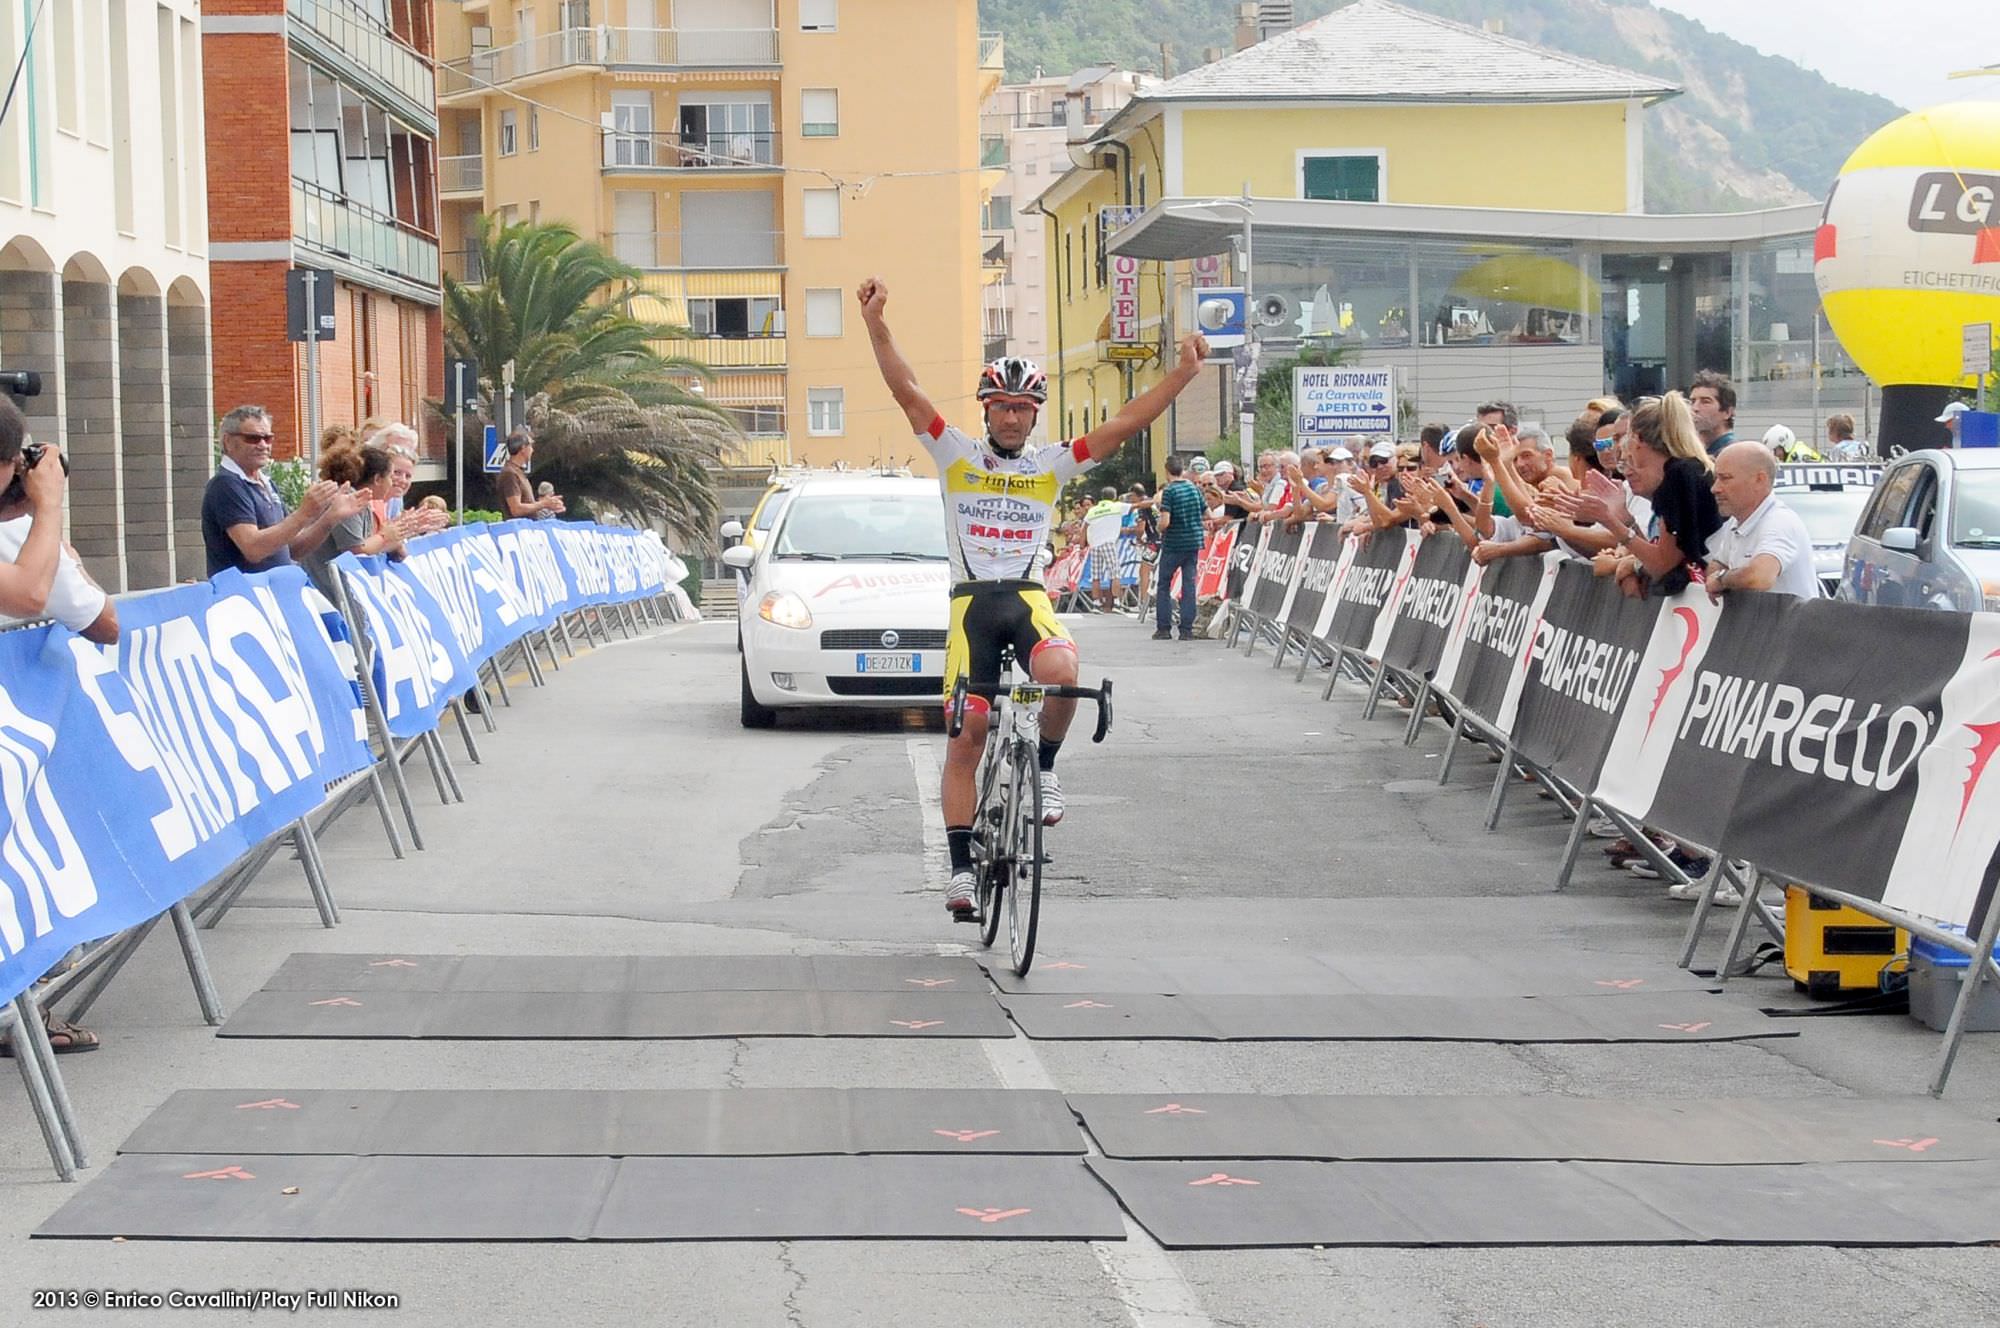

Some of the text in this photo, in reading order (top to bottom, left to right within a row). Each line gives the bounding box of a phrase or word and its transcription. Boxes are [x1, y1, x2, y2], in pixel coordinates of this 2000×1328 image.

[1918, 184, 2000, 224] LG
[1115, 256, 1135, 340] OTEL
[1303, 373, 1388, 387] HOTEL RISTORANTE
[1307, 389, 1383, 400] La Caravella
[1316, 403, 1368, 412] APERTO
[1304, 418, 1314, 430] P
[1318, 418, 1343, 429] AMPIO
[1774, 467, 1884, 485] HIMAN
[958, 503, 1044, 523] SAINT-GOBAIN
[813, 572, 950, 598] AUTOSERV
[1679, 670, 1929, 792] PINARELLO
